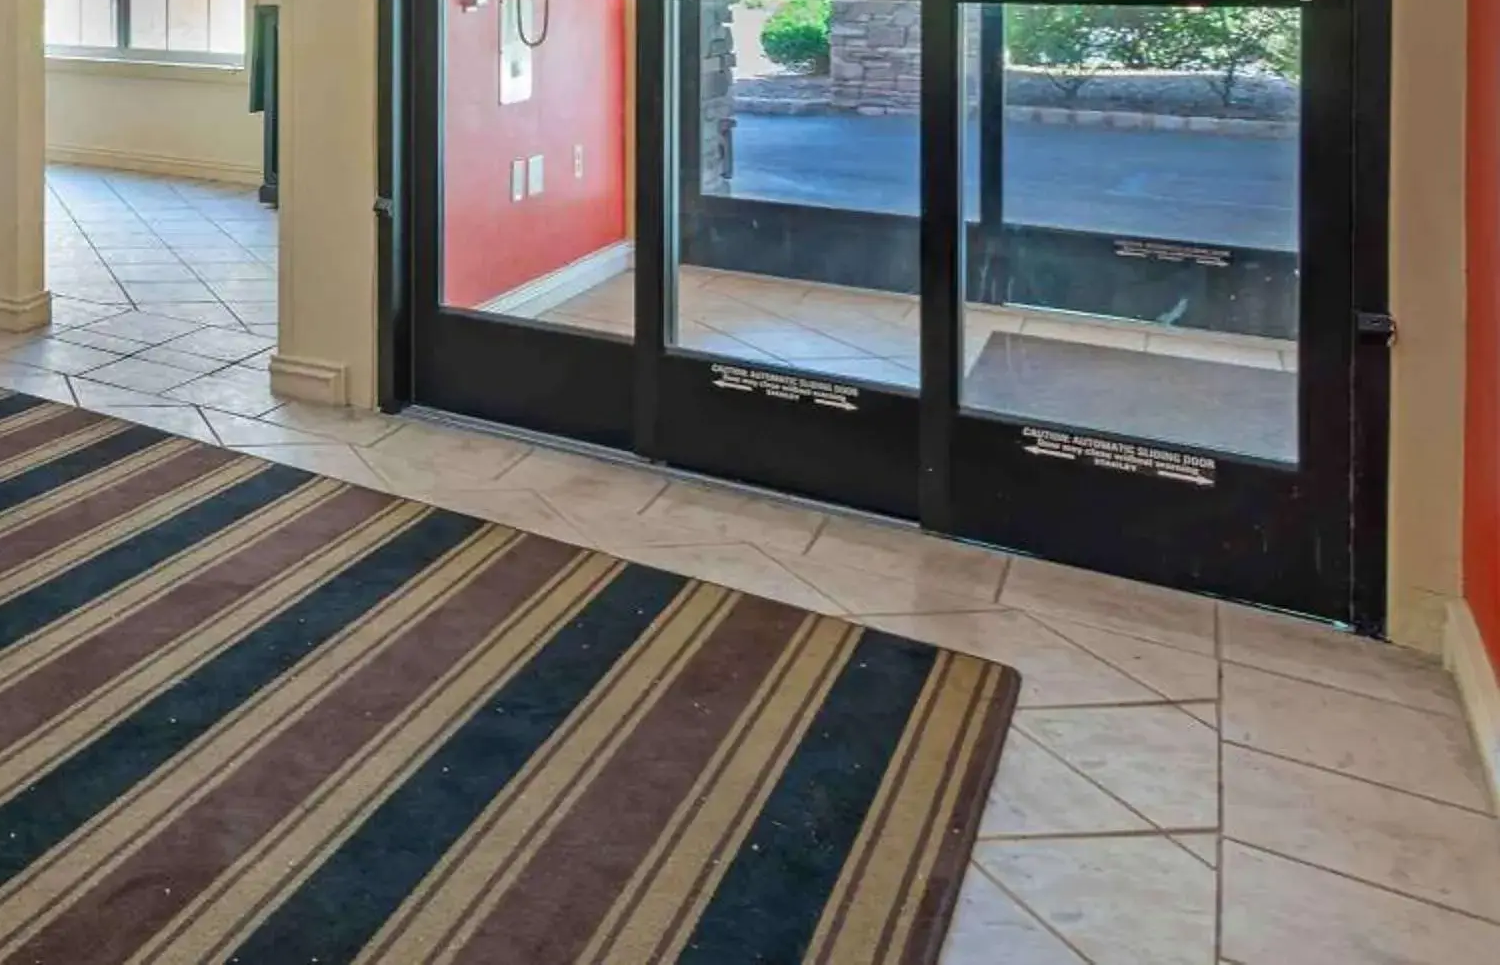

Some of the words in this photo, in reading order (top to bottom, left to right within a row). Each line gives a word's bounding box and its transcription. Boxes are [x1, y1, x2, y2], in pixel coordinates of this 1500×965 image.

[1071, 436, 1136, 455] AUTOMATIC
[1137, 447, 1182, 464] SLIDING
[1183, 454, 1216, 469] DOOR
